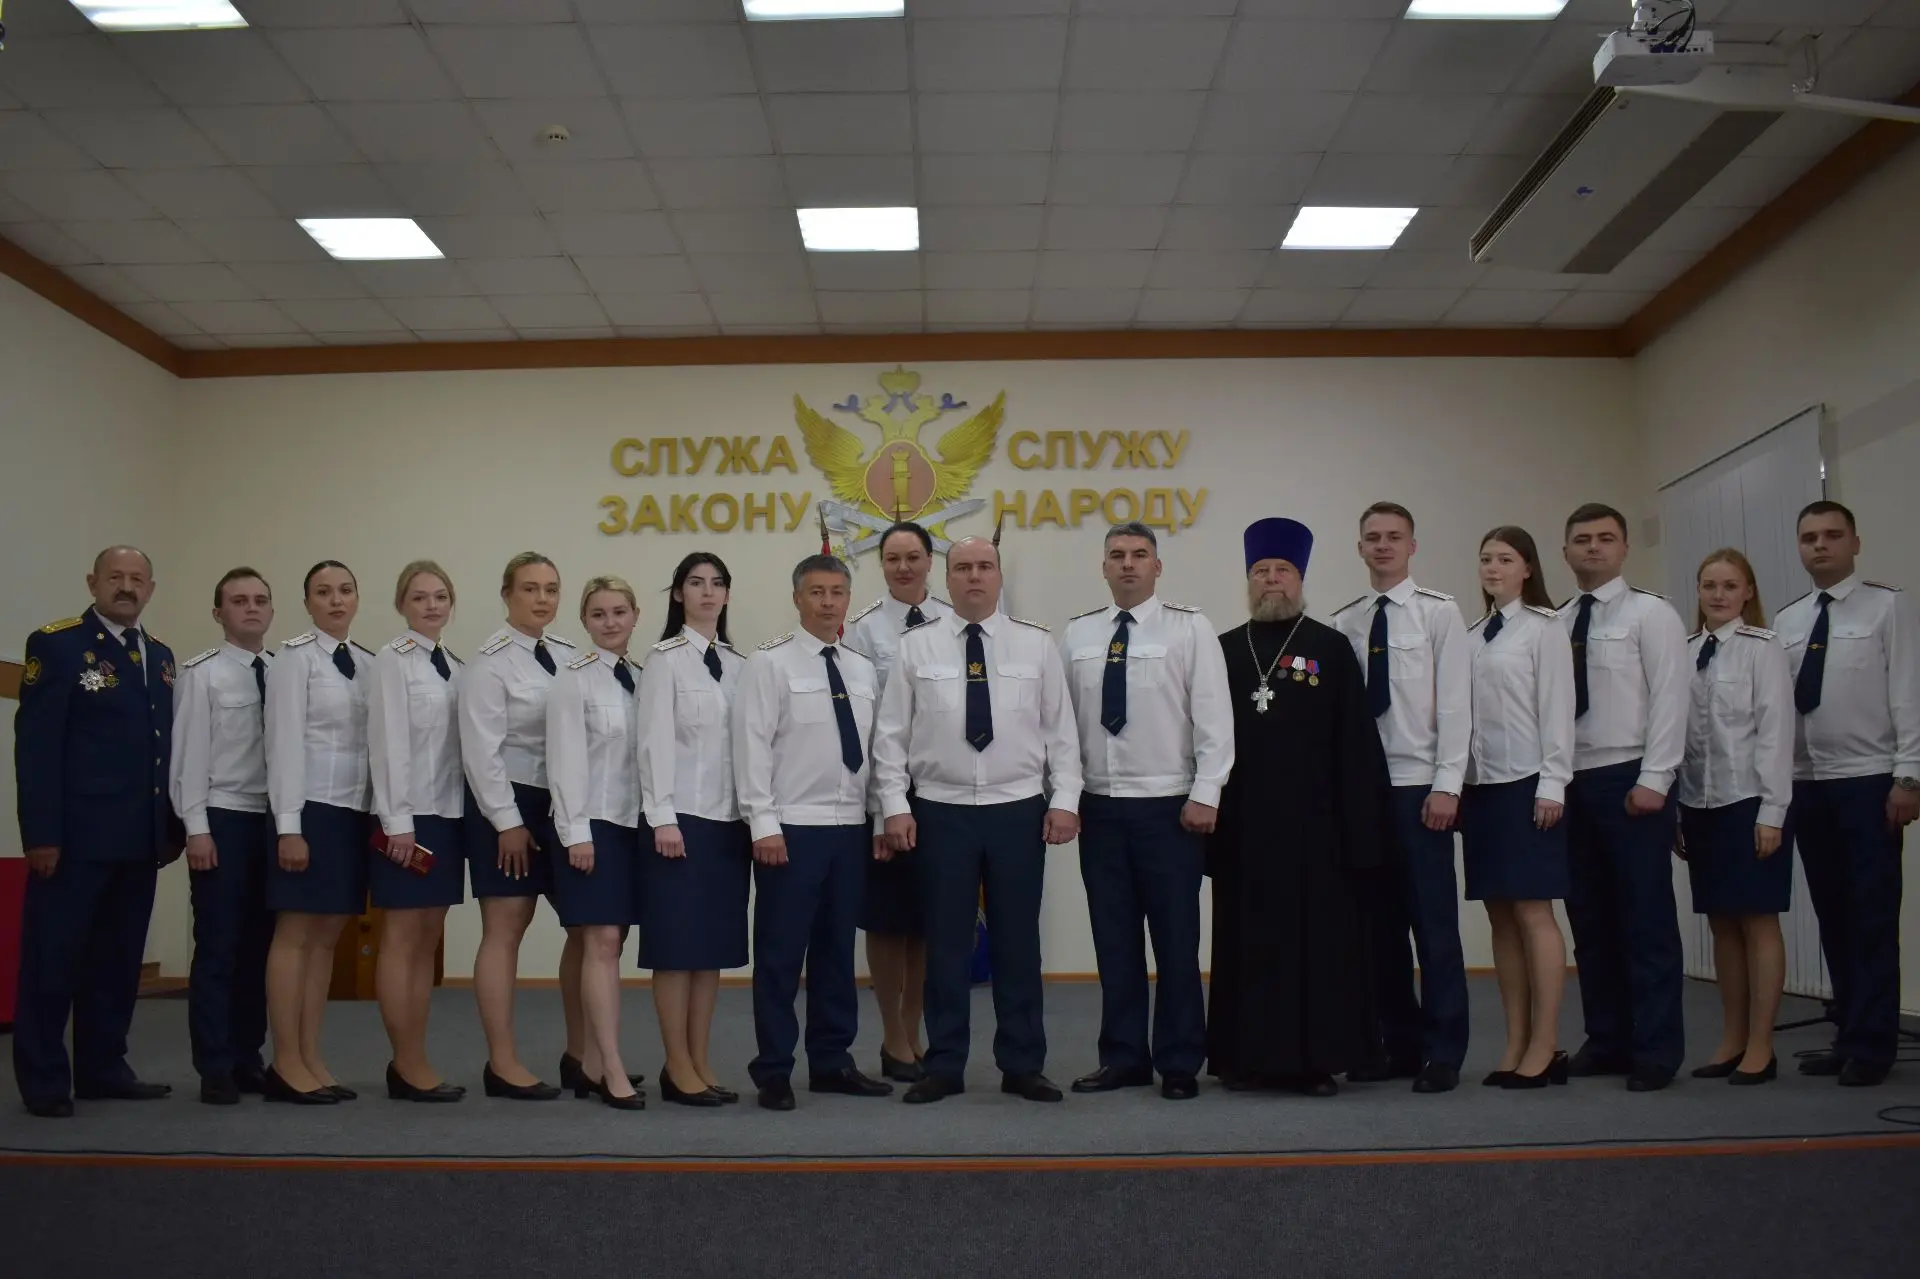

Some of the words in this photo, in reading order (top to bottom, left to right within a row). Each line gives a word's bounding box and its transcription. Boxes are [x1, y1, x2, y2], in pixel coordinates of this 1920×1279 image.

[610, 435, 799, 477] СЛУЖА
[1007, 429, 1190, 470] СЛУЖУ
[597, 491, 812, 535] ЗАКОНУ
[993, 487, 1208, 535] НАРОДУ
